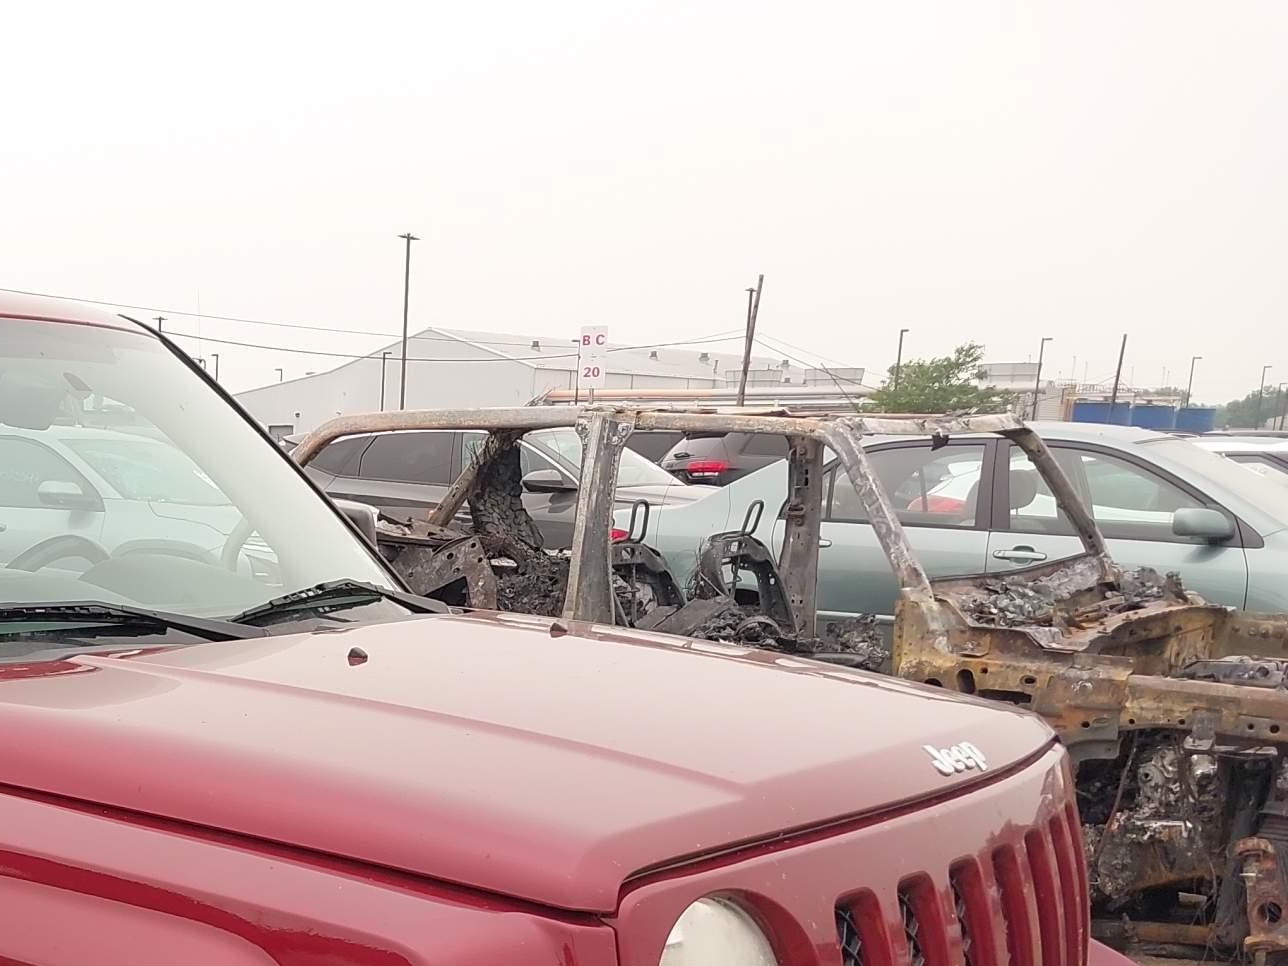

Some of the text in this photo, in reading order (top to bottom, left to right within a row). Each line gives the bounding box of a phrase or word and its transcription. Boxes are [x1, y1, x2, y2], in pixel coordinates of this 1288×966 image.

[582, 334, 605, 346] B C
[583, 366, 600, 378] 20
[921, 741, 988, 776] Jeep
